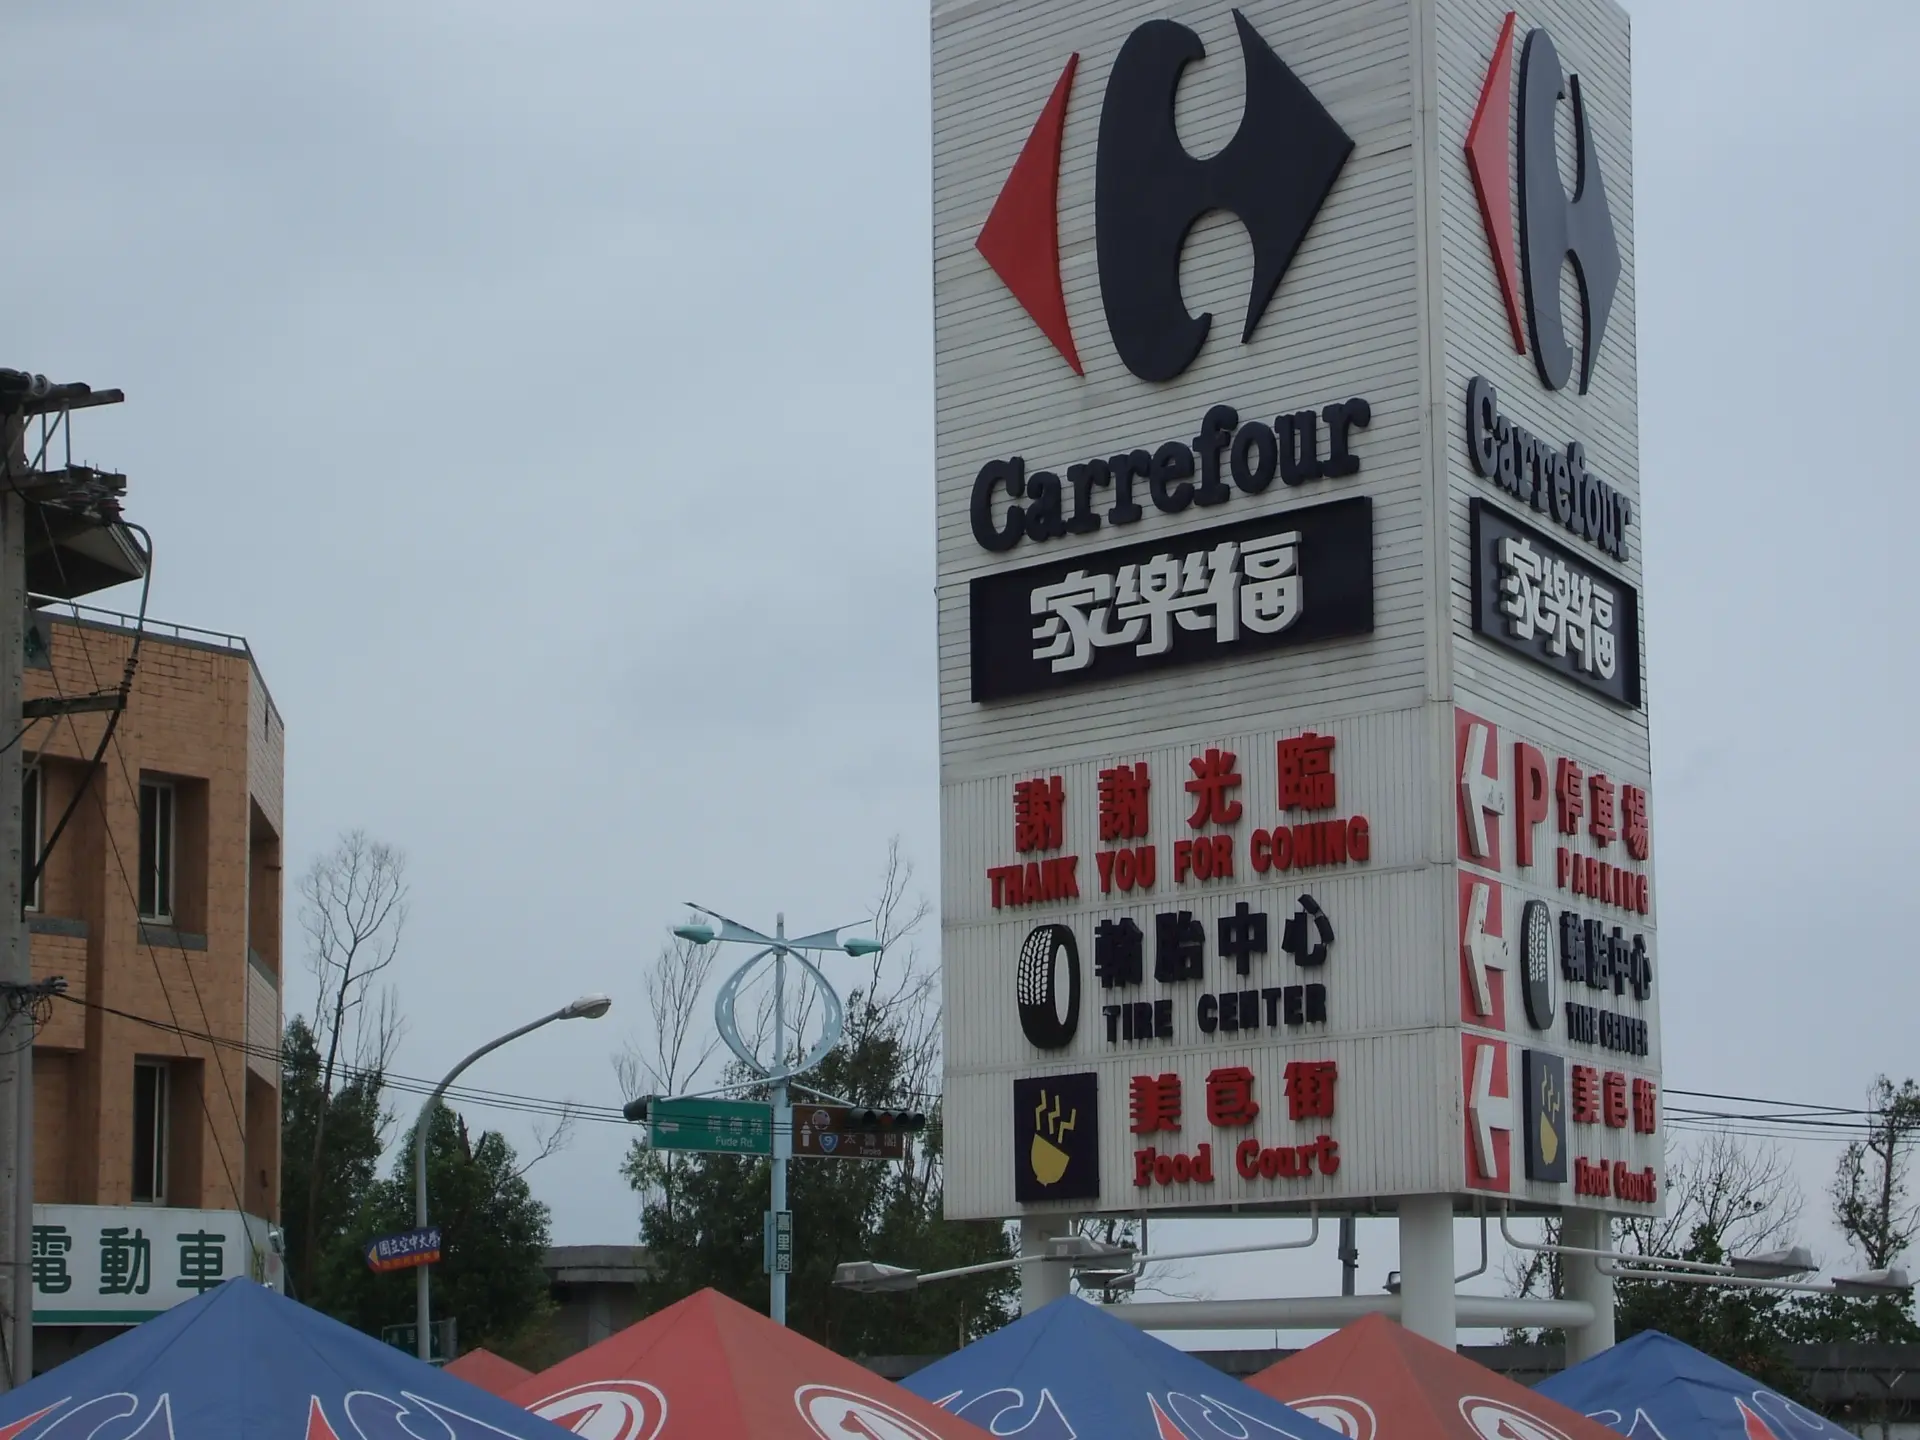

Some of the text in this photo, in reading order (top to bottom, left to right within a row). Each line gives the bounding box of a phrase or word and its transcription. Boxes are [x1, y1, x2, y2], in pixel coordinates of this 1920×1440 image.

[970, 397, 1371, 552] Carrefour
[1466, 375, 1632, 562] Carrefour
[1030, 531, 1303, 673] 家樂福
[1499, 537, 1616, 680] 家樂福
[1013, 732, 1337, 853] 謝謝光臨
[1514, 742, 1549, 867] P
[1556, 757, 1649, 860] 停車場
[987, 815, 1370, 908] THANK YOU FOR COMING
[1557, 847, 1649, 914] PARKING
[1095, 894, 1335, 988] 輪胎中心
[1559, 911, 1653, 1001] 輪胎中心
[1102, 983, 1327, 1043] TIRE CENTER
[1565, 1001, 1649, 1056] TIRE CENTER
[1129, 1060, 1338, 1133] 美食街
[1572, 1065, 1657, 1134] 美食街
[716, 1135, 739, 1147] Fude
[824, 1135, 833, 1146] 9
[1134, 1135, 1341, 1187] Food Court
[1575, 1156, 1657, 1203] Food Court
[33, 1225, 227, 1295] 電動車
